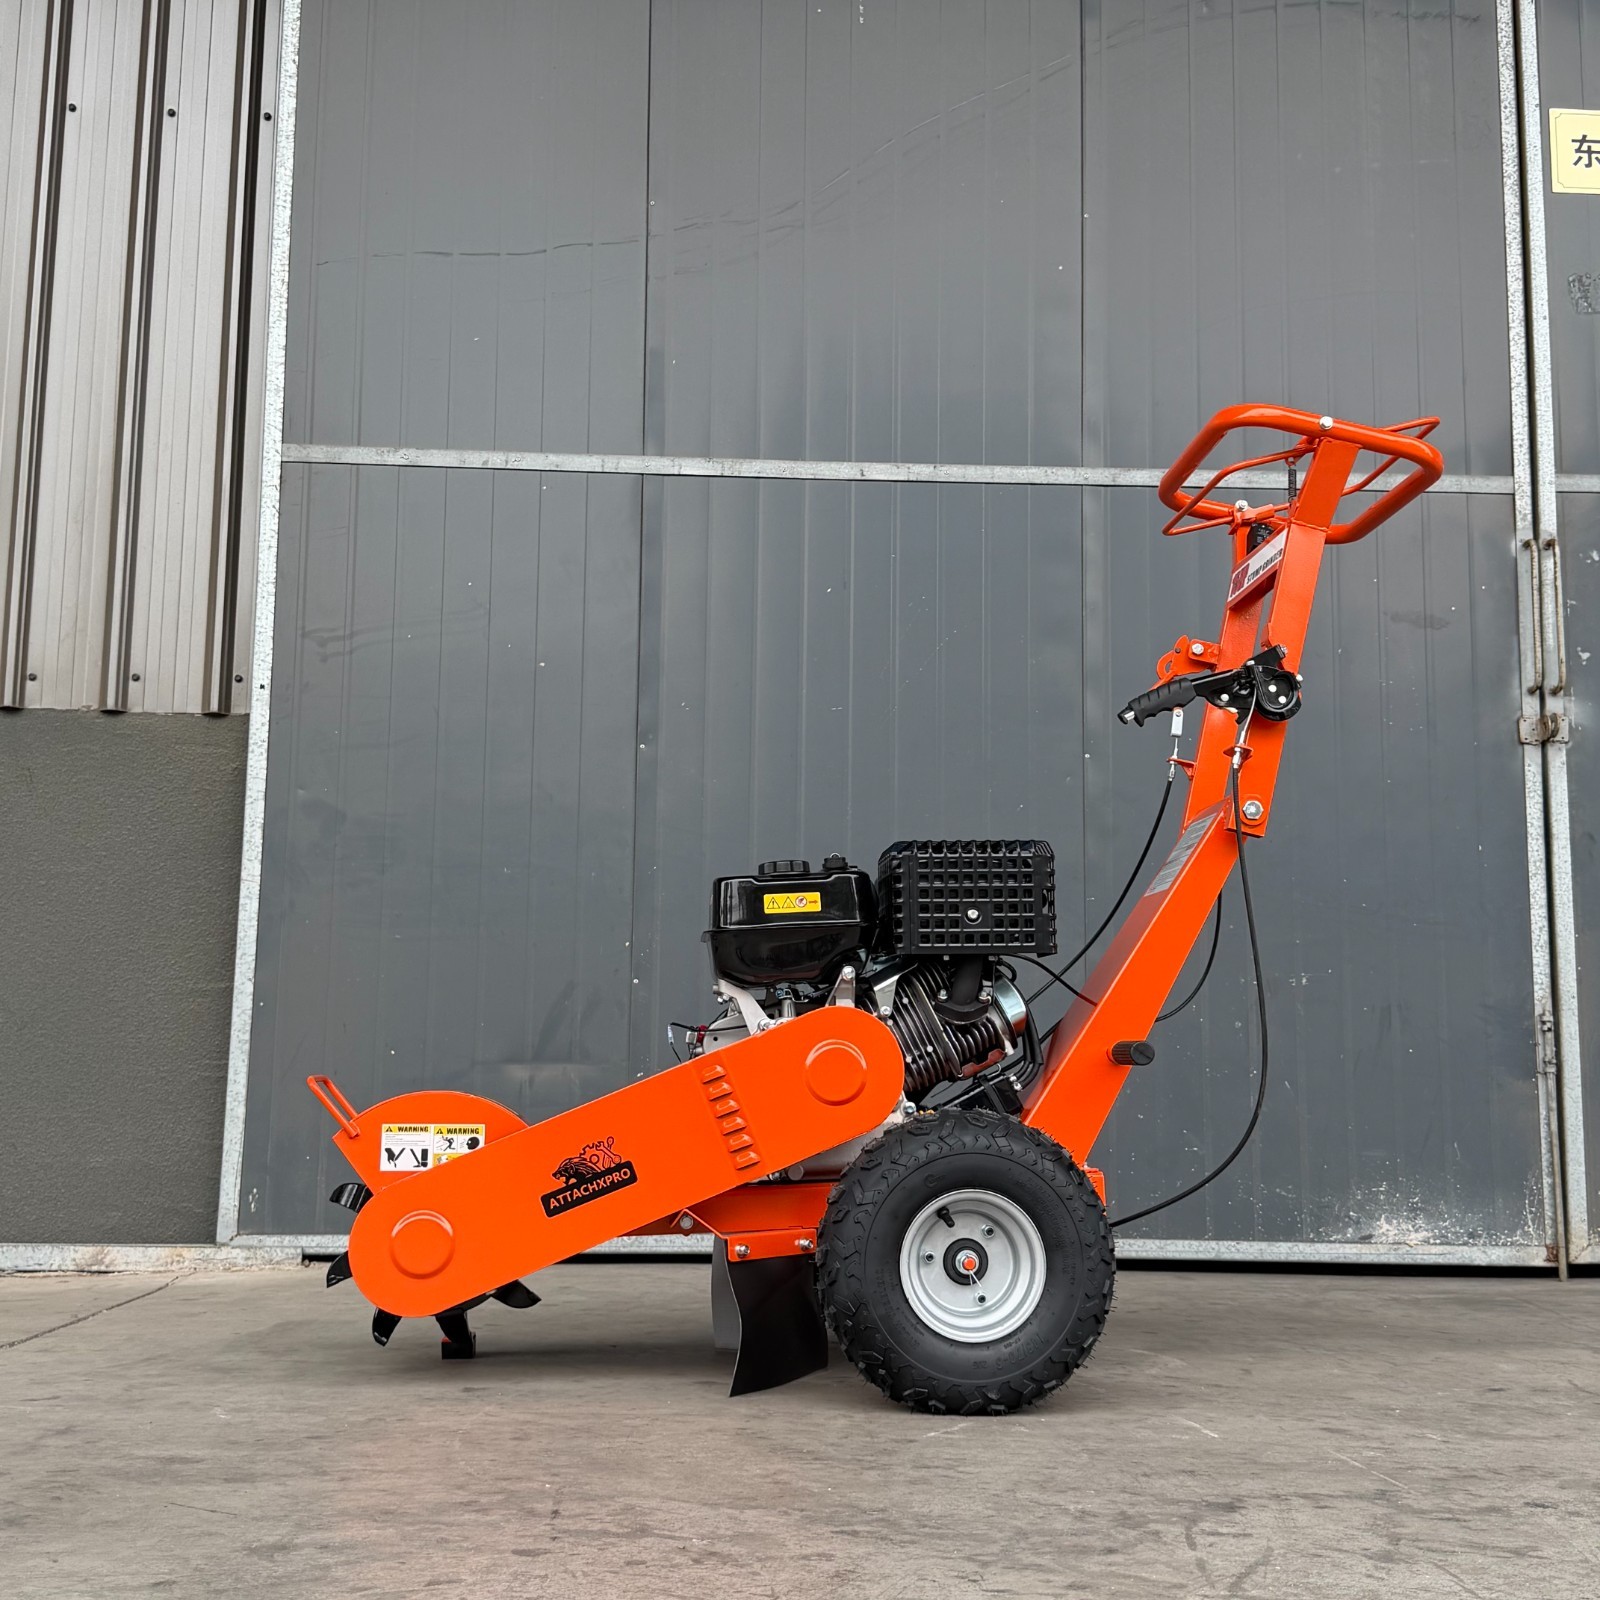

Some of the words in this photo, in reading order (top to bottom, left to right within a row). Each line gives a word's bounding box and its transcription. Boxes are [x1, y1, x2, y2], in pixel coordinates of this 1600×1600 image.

[1571, 134, 1600, 168] 东
[1246, 564, 1263, 584] STUMP
[1262, 548, 1283, 572] GRINDER
[397, 1125, 429, 1133] WARNING
[446, 1127, 480, 1135] WARNING
[549, 1168, 631, 1210] ATTACHXPRO
